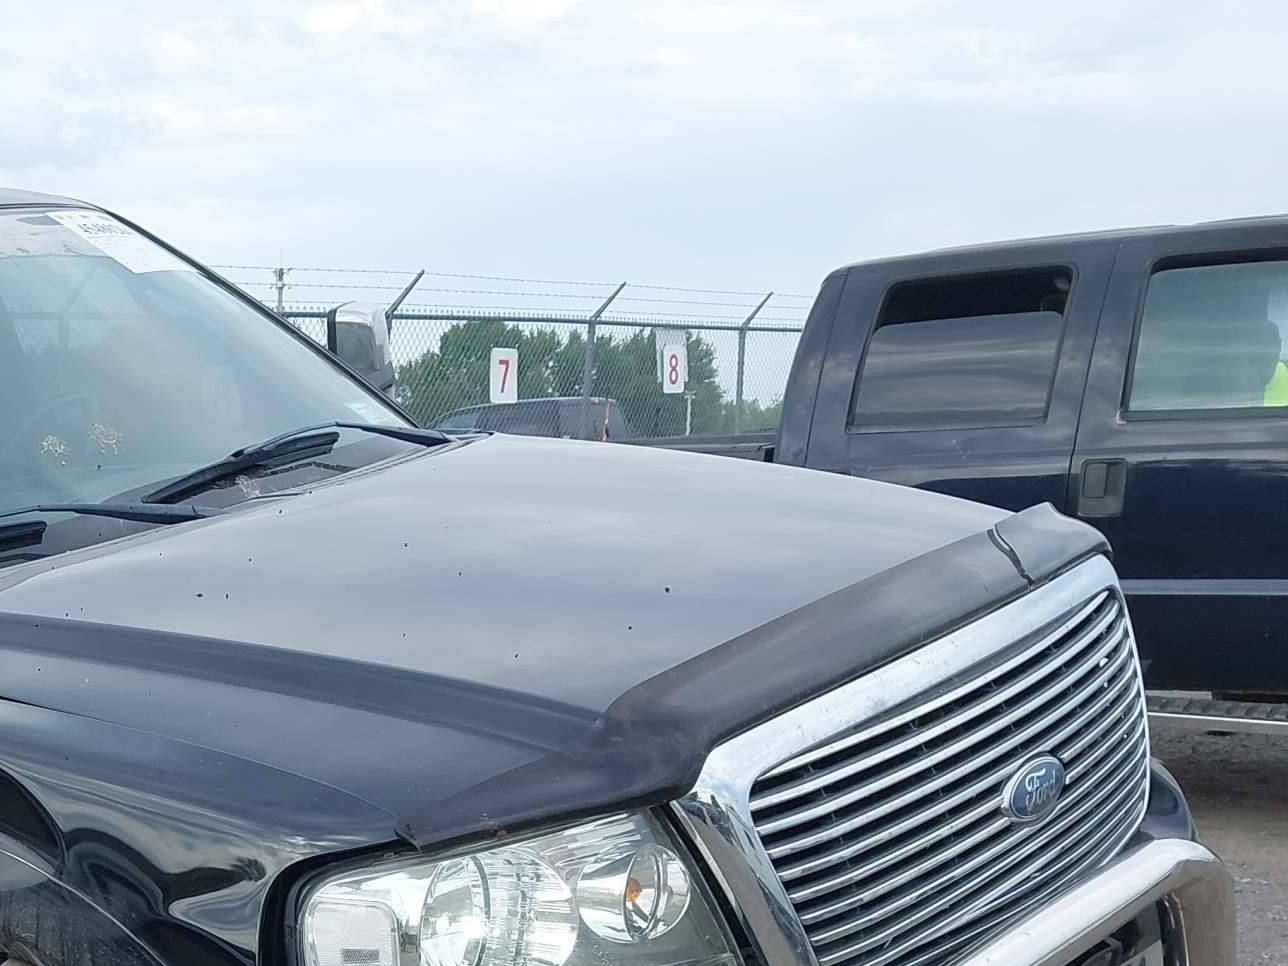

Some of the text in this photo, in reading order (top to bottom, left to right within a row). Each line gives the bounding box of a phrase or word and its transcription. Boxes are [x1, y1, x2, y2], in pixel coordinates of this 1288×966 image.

[497, 358, 511, 395] 7
[668, 352, 680, 386] 8
[1025, 766, 1057, 812] Ford
